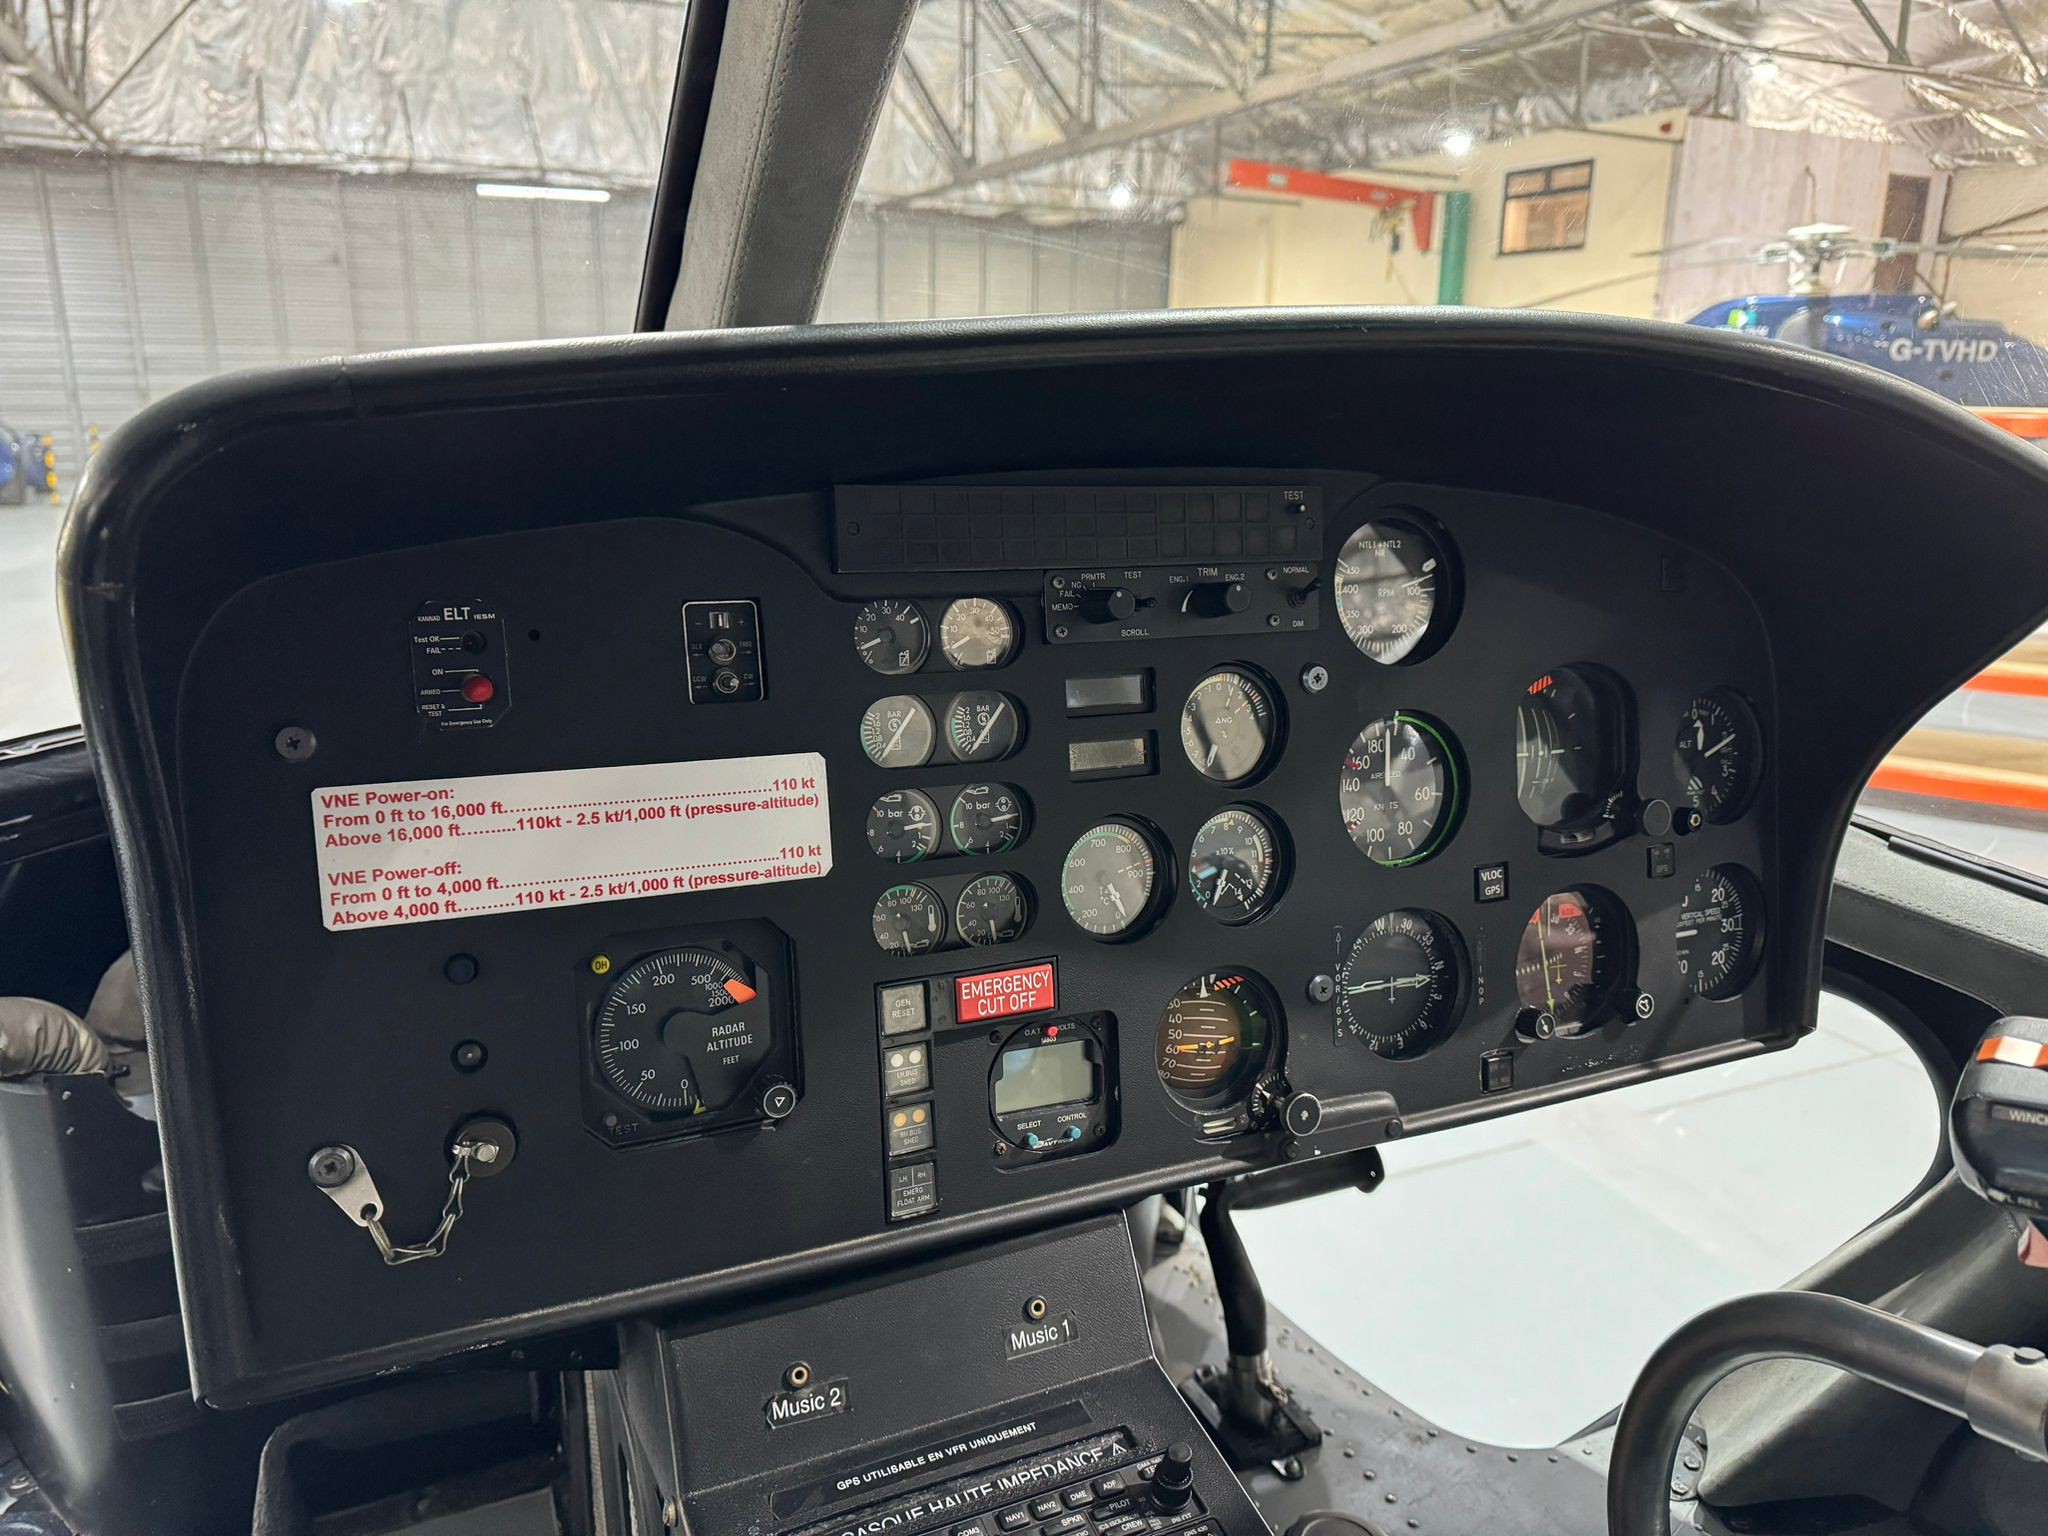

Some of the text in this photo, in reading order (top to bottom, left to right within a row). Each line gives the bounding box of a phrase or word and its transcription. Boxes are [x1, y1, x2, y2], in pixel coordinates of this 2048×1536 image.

[1889, 337, 1998, 363] G-TVHD
[1284, 491, 1305, 500] TEST
[1124, 571, 1142, 579] TEST
[1197, 568, 1218, 577] TRIM
[1283, 566, 1309, 574] NORMAL
[1081, 573, 1106, 581] PRMTR
[1059, 590, 1075, 598] FAIL
[1051, 603, 1073, 611] MEMO
[443, 607, 470, 620] ELT
[1121, 629, 1149, 637] SCROLL
[1368, 740, 1384, 753] 180
[1401, 747, 1415, 760] 40
[1343, 778, 1360, 792] 140
[321, 788, 455, 809] VNE Power-on:
[1415, 787, 1429, 800] 60
[323, 813, 369, 828] From
[375, 811, 385, 824] 0
[391, 809, 404, 822] ft
[408, 810, 425, 822] to
[431, 802, 486, 820] 16,000
[801, 777, 815, 790] kt
[976, 800, 990, 809] bar
[888, 809, 903, 818] bar
[325, 831, 382, 848] Above
[387, 825, 443, 843] 16,000
[576, 812, 600, 825] 2.5
[605, 806, 666, 824] kt/1,000
[670, 805, 681, 818] ft
[685, 793, 820, 819] (pressure-altitude)
[1398, 821, 1412, 835] 80
[1367, 828, 1384, 842] 100
[1091, 839, 1106, 848] 700
[1115, 845, 1131, 853] 800
[1069, 859, 1085, 867] 600
[328, 861, 462, 886] VNE Power-off:
[330, 891, 376, 906] From
[382, 888, 392, 901] 0
[397, 886, 410, 900] ft
[414, 887, 432, 898] to
[437, 879, 482, 897] 4,000
[808, 844, 822, 857] kt
[1481, 869, 1503, 881] VLOC
[332, 909, 388, 926] Above
[394, 902, 439, 920] 4,000
[549, 889, 566, 902] kt
[580, 886, 603, 899] 2.5
[608, 878, 669, 895] kt/1,000
[673, 876, 684, 889] ft
[688, 861, 822, 889] (pressure-altitude)
[1485, 884, 1500, 895] GPS
[1721, 918, 1734, 933] 30
[595, 961, 607, 970] DH
[652, 973, 675, 986] 200
[691, 974, 711, 985] 500
[961, 971, 1050, 1000] EMERGENCY
[626, 1003, 646, 1015] 150
[895, 999, 911, 1008] GEN
[978, 991, 1037, 1016] CUT OFF
[892, 1007, 915, 1018] RESET
[1168, 1014, 1182, 1024] 40
[712, 1022, 745, 1037] RADAR
[1168, 1030, 1182, 1040] 50
[620, 1039, 639, 1051] 100
[707, 1034, 753, 1052] ALTITUDE
[723, 1055, 740, 1065] FEET
[1162, 1058, 1176, 1068] 70
[641, 1069, 655, 1080] 50
[681, 1079, 689, 1089] 0
[1057, 1112, 1087, 1123] CONTROL
[609, 1123, 639, 1136] TEST
[1017, 1120, 1041, 1131] SELECT
[897, 1196, 915, 1207] FLOAT
[1011, 1319, 1071, 1352] Music 1
[772, 1387, 842, 1421] Music 2
[836, 1422, 1037, 1491] GPS UTILISABLE EN VFR UNIQUEMENT
[1102, 1479, 1117, 1491] ADF
[1070, 1491, 1088, 1502] DME
[1037, 1500, 1057, 1512] NAV2
[1109, 1498, 1131, 1511] PILOT
[1005, 1511, 1025, 1523] NAV1
[1061, 1514, 1083, 1526] SPKR
[1121, 1518, 1143, 1531] CREW
